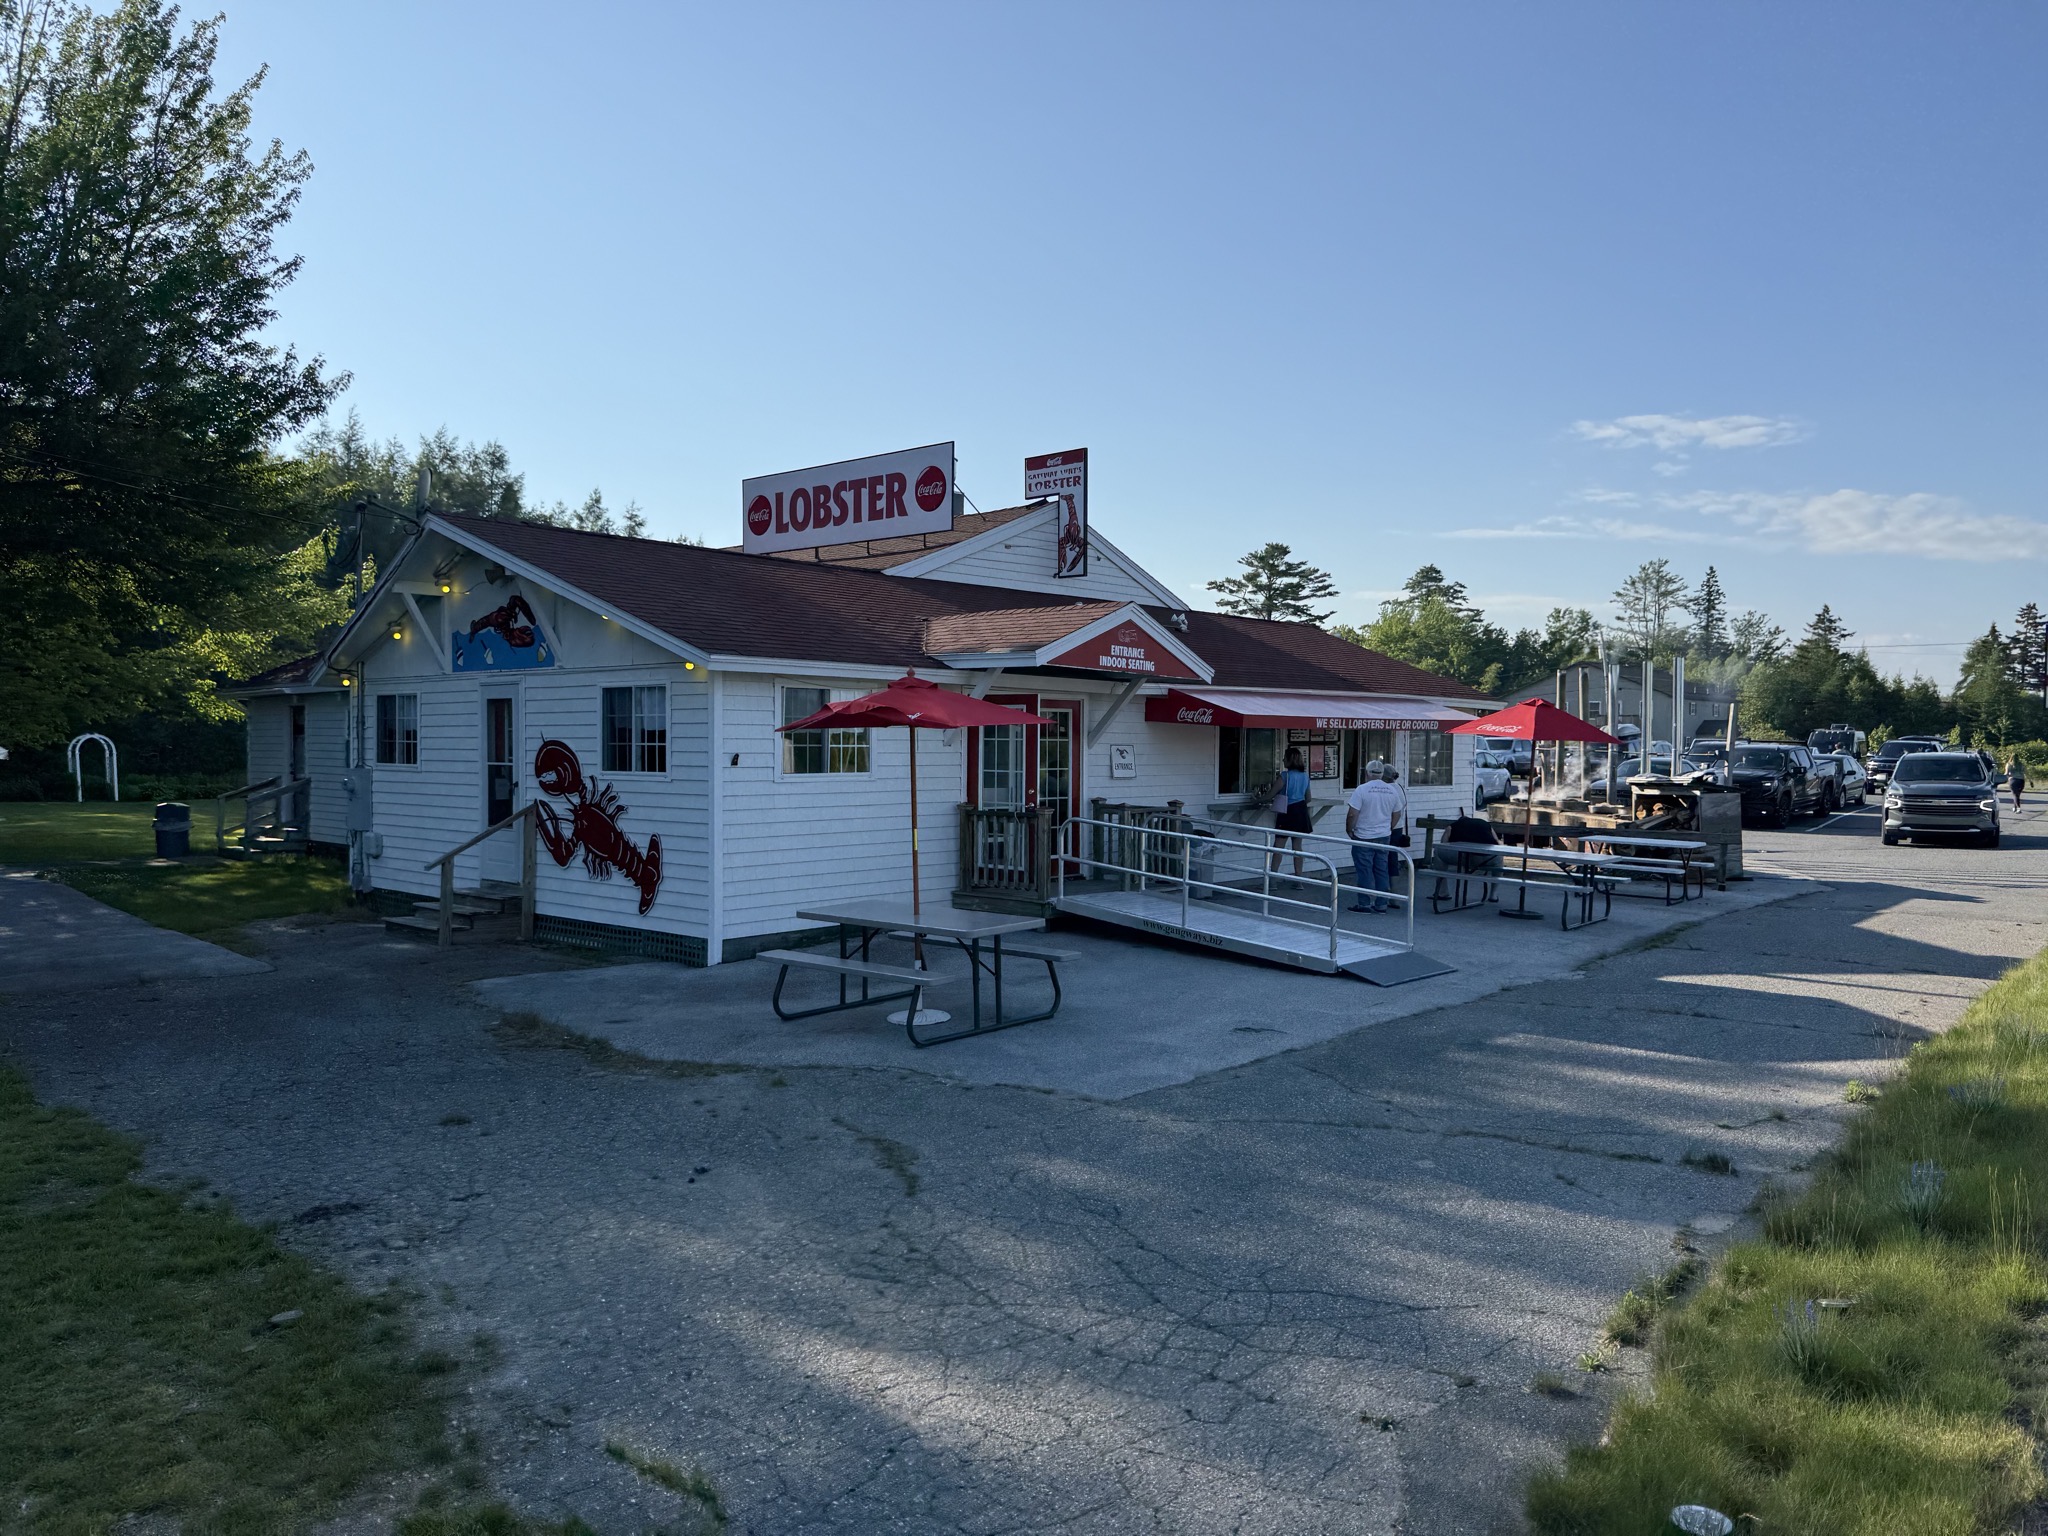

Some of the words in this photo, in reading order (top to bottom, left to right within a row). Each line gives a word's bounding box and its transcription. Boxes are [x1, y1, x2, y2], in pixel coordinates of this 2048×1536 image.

[1028, 475, 1082, 493] LOBSTER
[775, 472, 908, 534] LOBSTER
[1111, 645, 1145, 659] ENTRANCE
[1099, 655, 1127, 669] INDOOR
[1128, 658, 1155, 672] SEATING
[1316, 718, 1328, 728] WE
[1329, 718, 1347, 729] SELL
[1348, 719, 1385, 730] LOBSTERS
[1385, 720, 1401, 730] LIVE
[1401, 720, 1412, 730] OR
[1412, 720, 1439, 730] COOKED
[1143, 920, 1224, 946] www.gangways.biz
